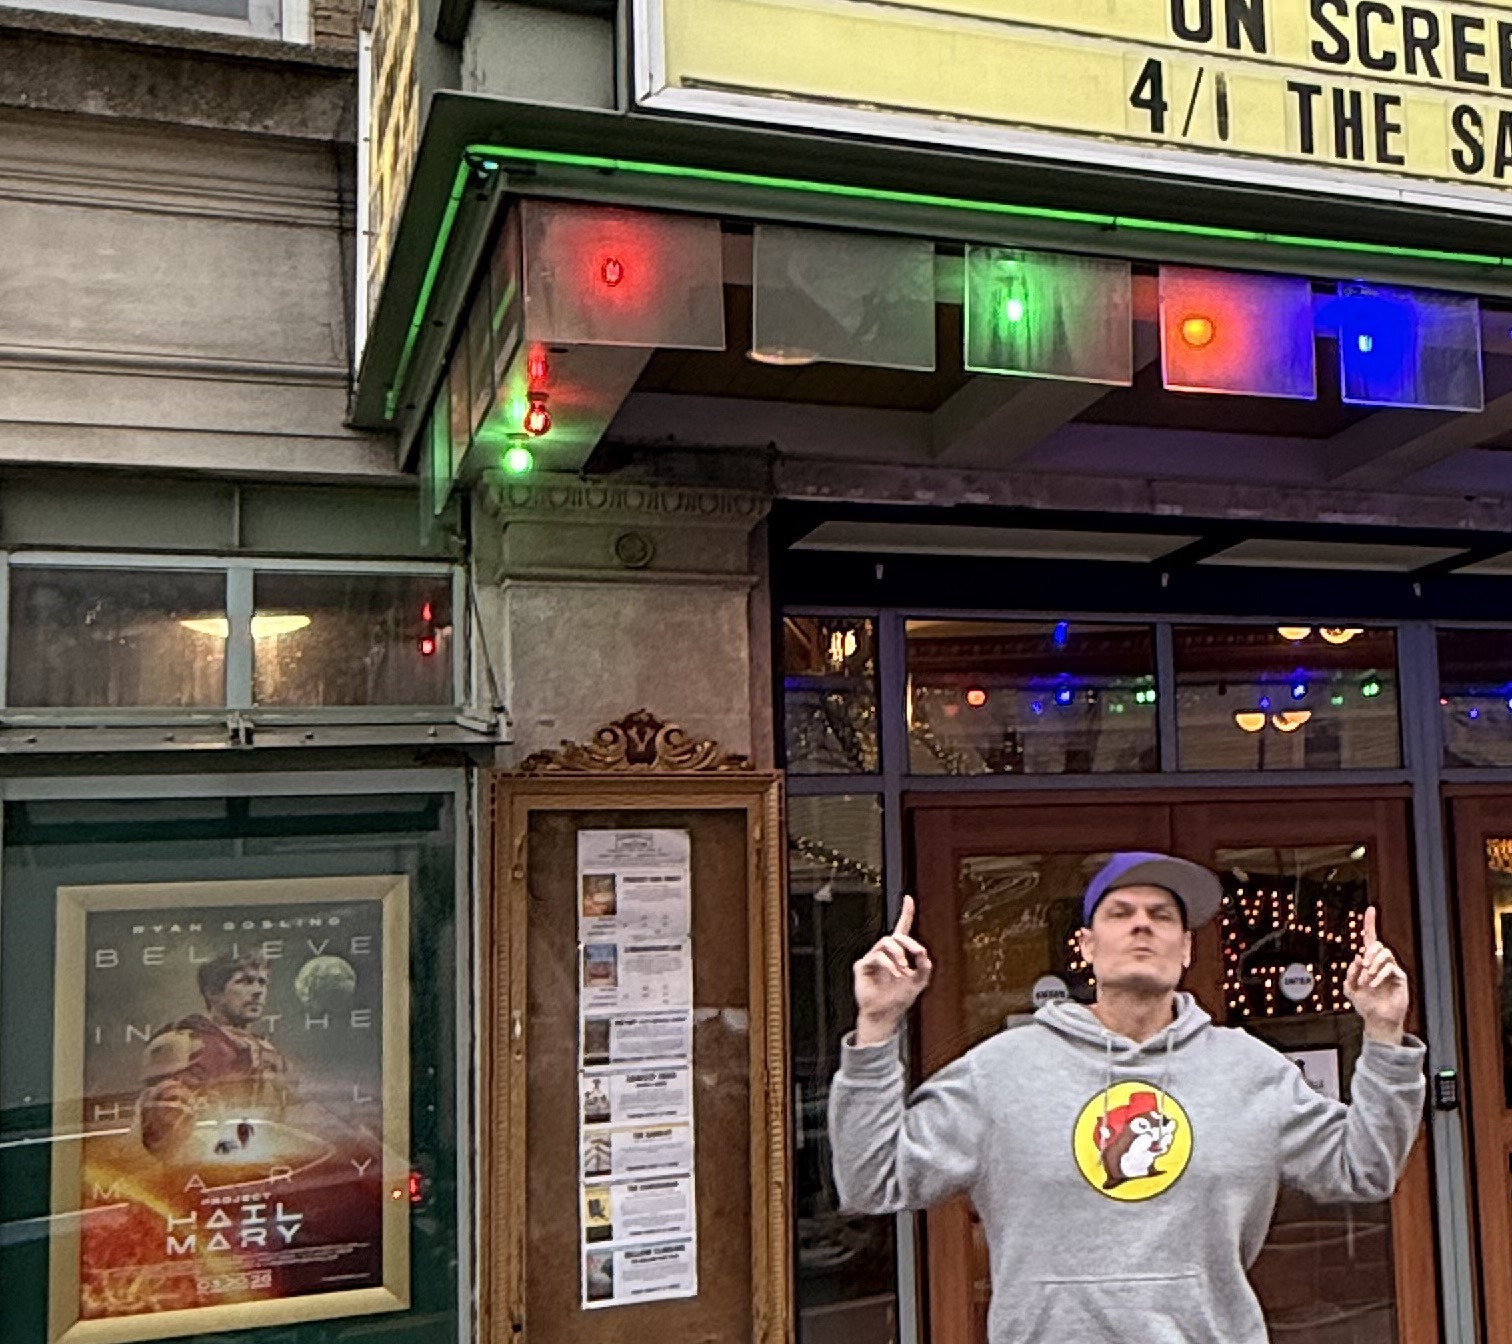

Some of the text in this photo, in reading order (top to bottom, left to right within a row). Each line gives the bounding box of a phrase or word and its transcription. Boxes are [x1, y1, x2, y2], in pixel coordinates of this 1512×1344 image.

[1129, 56, 1230, 142] 4/1
[1286, 79, 1406, 166] THE
[131, 922, 203, 935] RYAN
[94, 935, 373, 969] BELIEVE
[94, 1008, 372, 1045] IN THE
[166, 1201, 303, 1233] HAIL
[165, 1222, 303, 1256] MARY
